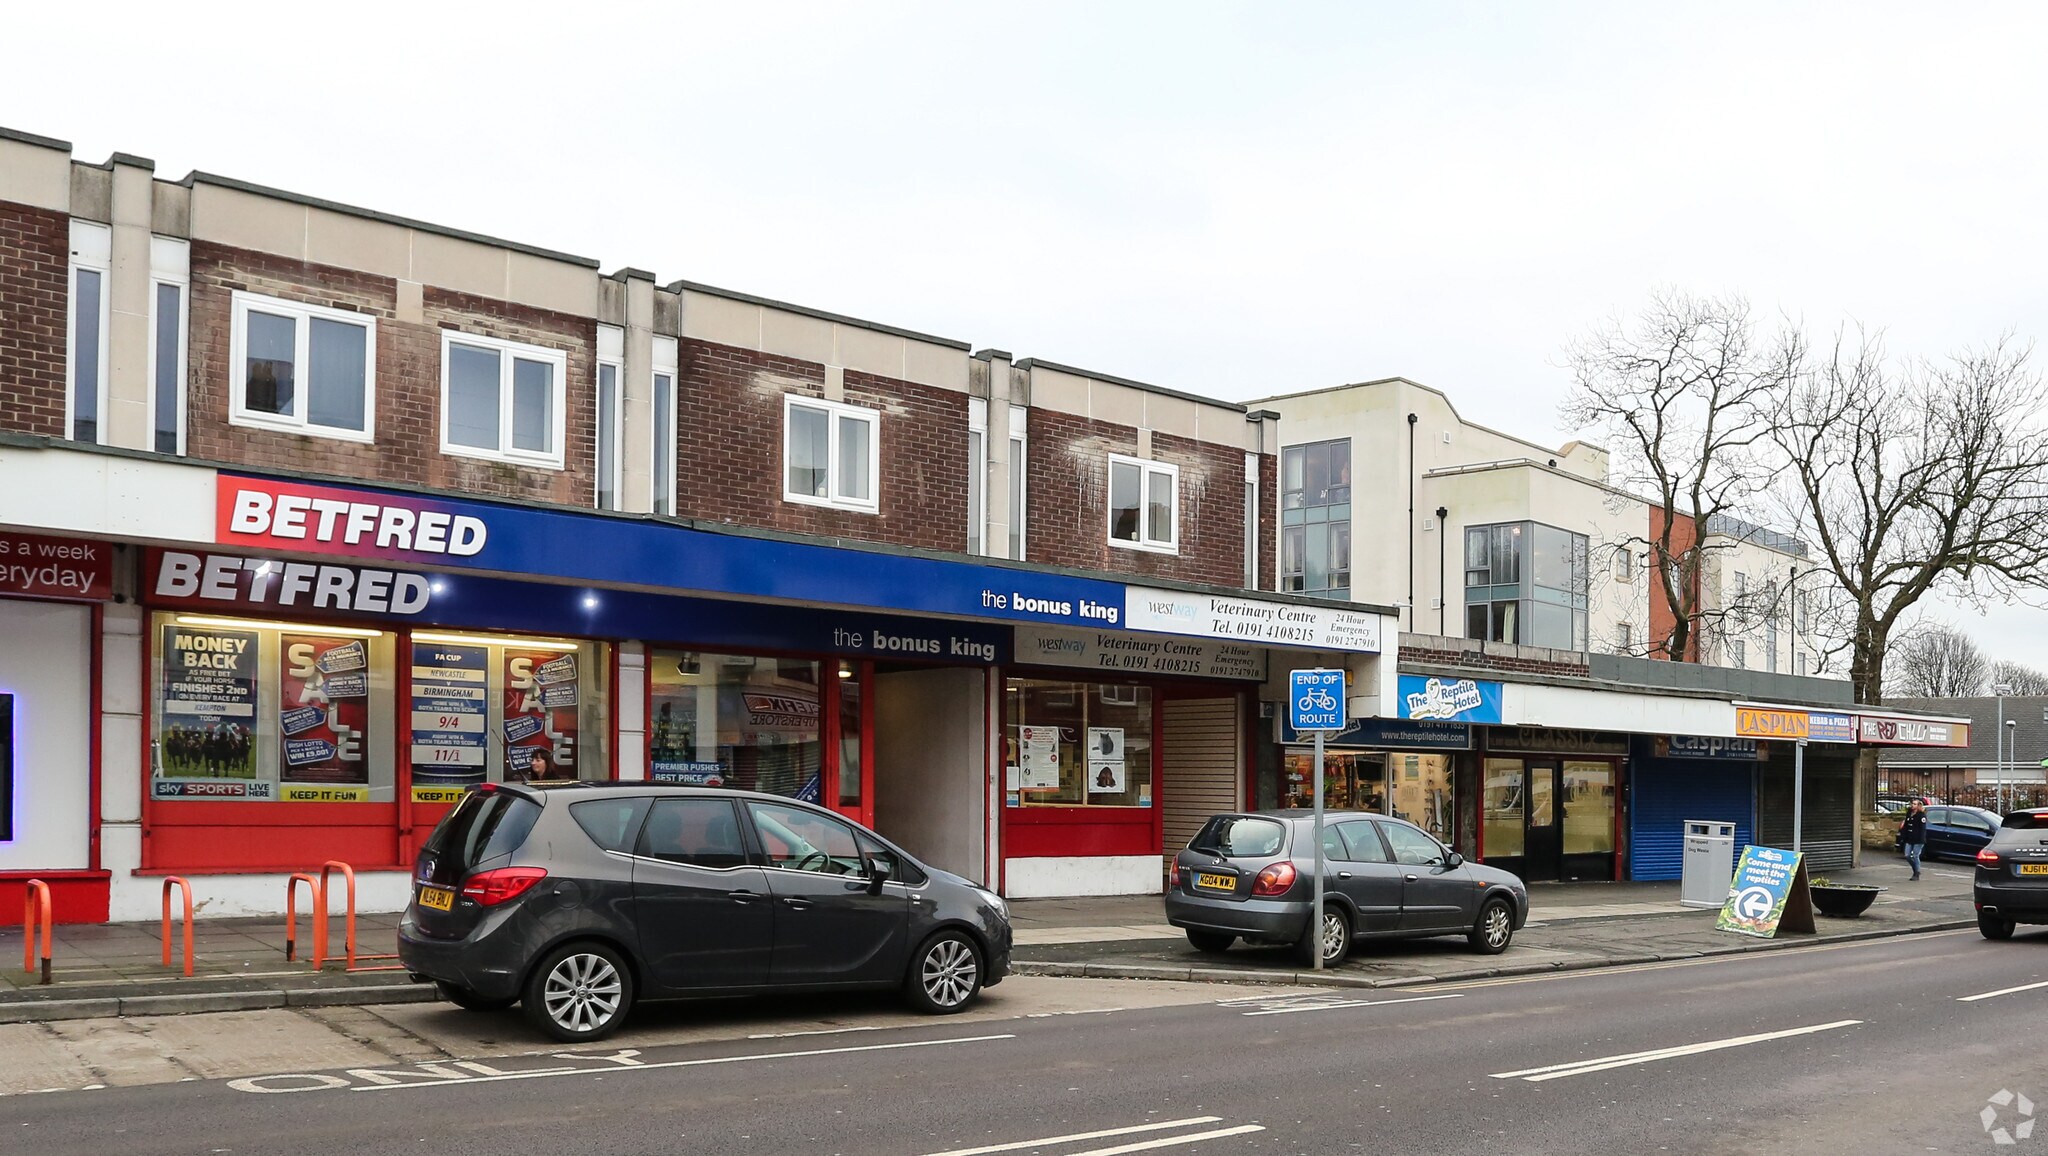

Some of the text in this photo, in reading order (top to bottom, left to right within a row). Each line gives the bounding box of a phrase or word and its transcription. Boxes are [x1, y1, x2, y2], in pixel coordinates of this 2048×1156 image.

[230, 489, 488, 556] BETFRED
[18, 542, 31, 556] a
[38, 544, 96, 561] week
[0, 563, 96, 594] eryday
[155, 551, 431, 615] BETFRED
[982, 589, 1119, 624] the bonus king
[1210, 599, 1317, 624] Veterinary Centre
[1335, 613, 1366, 625] 24 Hour
[1212, 619, 1315, 642] Tel. 0191 4108215
[1330, 623, 1371, 637] Emergency
[174, 634, 248, 654] MONEY
[833, 627, 995, 661] the bonus king
[1096, 634, 1202, 656] Veterinary Centre
[1325, 634, 1376, 648] 0191 2747910
[434, 653, 445, 661] FA
[1219, 645, 1250, 656] 24 Hour
[183, 651, 238, 670] BACK
[1098, 652, 1201, 673] Tel. 0191 4108215
[1214, 654, 1255, 667] Emergency
[430, 670, 466, 679] NEWCASTLE
[1209, 665, 1229, 675] 0191
[1296, 675, 1338, 685] END OF
[172, 683, 248, 695] FINISHES 2ND
[423, 687, 474, 698] BIRMINGHAM
[1440, 681, 1474, 699] Reptile
[1409, 693, 1480, 709] The Hotel
[439, 716, 459, 728] 9/4
[1299, 714, 1336, 724] ROUTE
[1740, 711, 1806, 734] CASPIAN
[1809, 715, 1828, 725] KEBAB
[1833, 717, 1850, 727] PIZZA
[1381, 730, 1466, 743] www.thereptilehotel.com
[1863, 721, 1877, 736] THE
[1877, 721, 1897, 740] RED
[289, 752, 305, 760] WIN
[435, 749, 460, 762] 11/1
[654, 762, 720, 772] PREMIER PUSHES
[654, 773, 703, 783] BEST PRICE
[159, 783, 244, 795] sky SPORTS
[248, 783, 270, 791] LIVE
[290, 790, 357, 800] KEEP IT FUN
[417, 792, 443, 801] KEEP
[445, 792, 455, 801] IT
[1746, 857, 1792, 871] Come and
[1745, 867, 1786, 879] meet the
[1745, 874, 1780, 886] reptiles
[226, 1049, 645, 1094] ONLY
